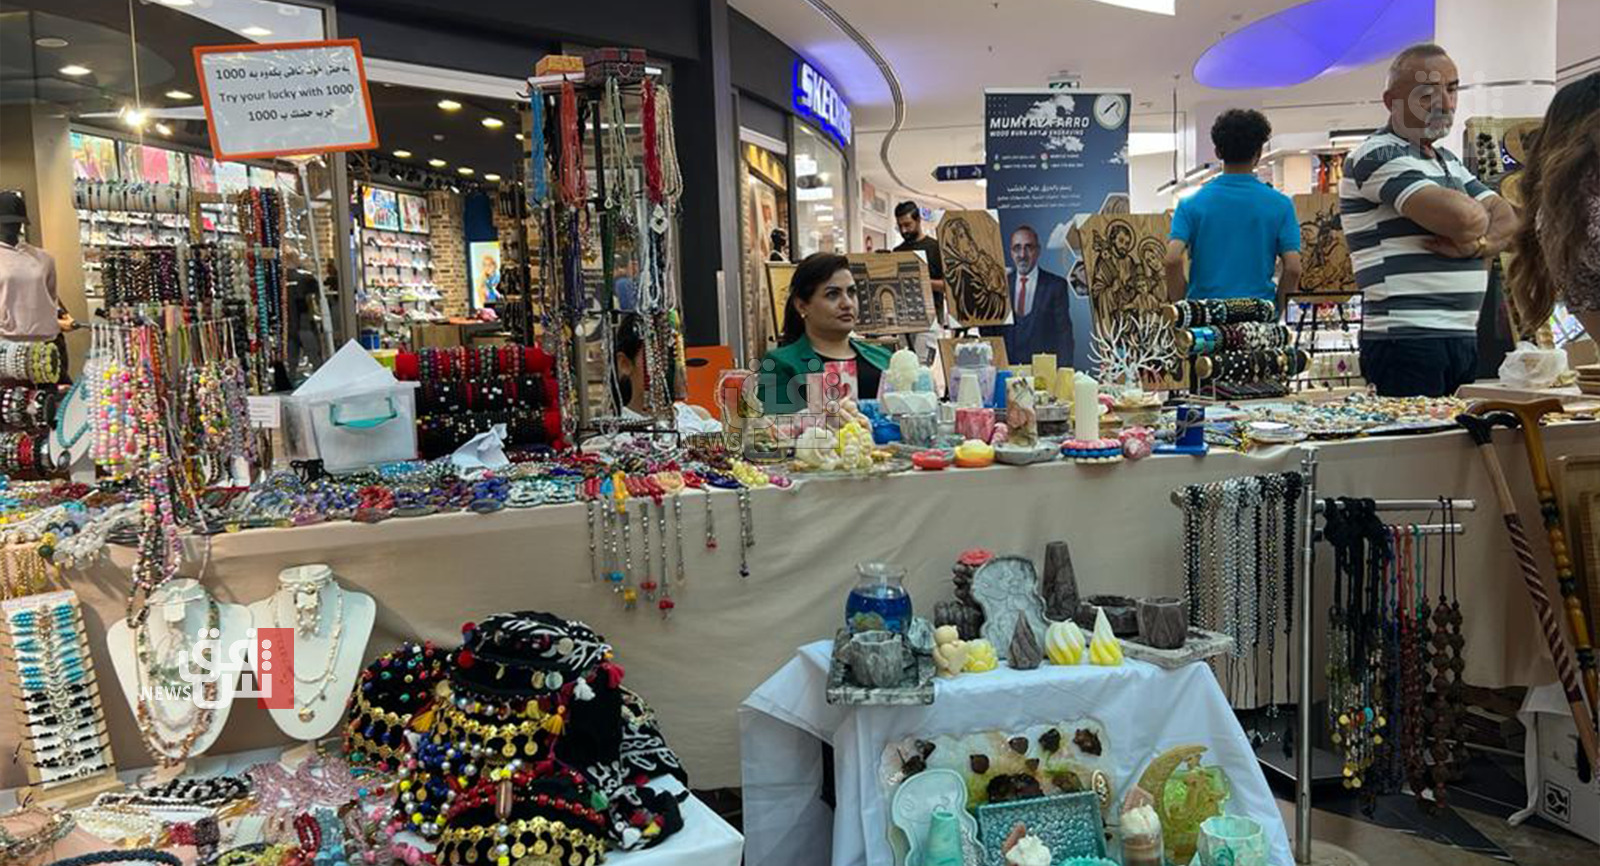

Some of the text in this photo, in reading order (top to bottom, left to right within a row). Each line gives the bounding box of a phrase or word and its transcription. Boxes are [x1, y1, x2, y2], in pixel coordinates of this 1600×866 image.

[216, 68, 246, 80] 1000
[219, 84, 355, 105] Try your lucky with 1000
[248, 110, 278, 122] 1000
